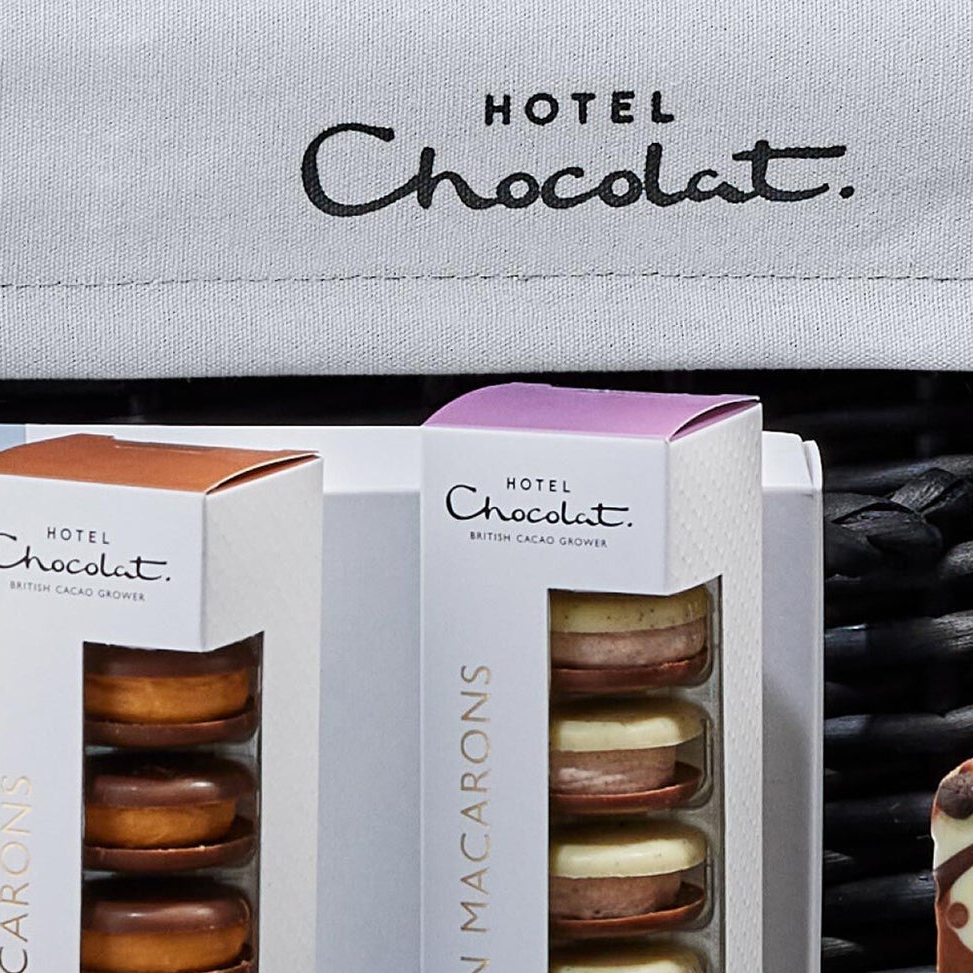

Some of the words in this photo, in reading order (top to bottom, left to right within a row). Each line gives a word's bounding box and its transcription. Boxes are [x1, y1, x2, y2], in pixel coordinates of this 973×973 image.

[484, 91, 675, 125] HOTEL
[301, 122, 855, 217] Chocolat.
[506, 477, 571, 493] HOTEL
[445, 484, 633, 528] Chocolat.
[46, 527, 110, 544] HOTEL
[470, 531, 511, 542] BRITISH
[516, 534, 555, 545] CACAO
[559, 536, 607, 549] GROWER
[10, 580, 51, 592] BRITISH
[55, 585, 93, 597] CACAO
[98, 589, 146, 602] GROWER
[460, 664, 492, 932] MACARONS
